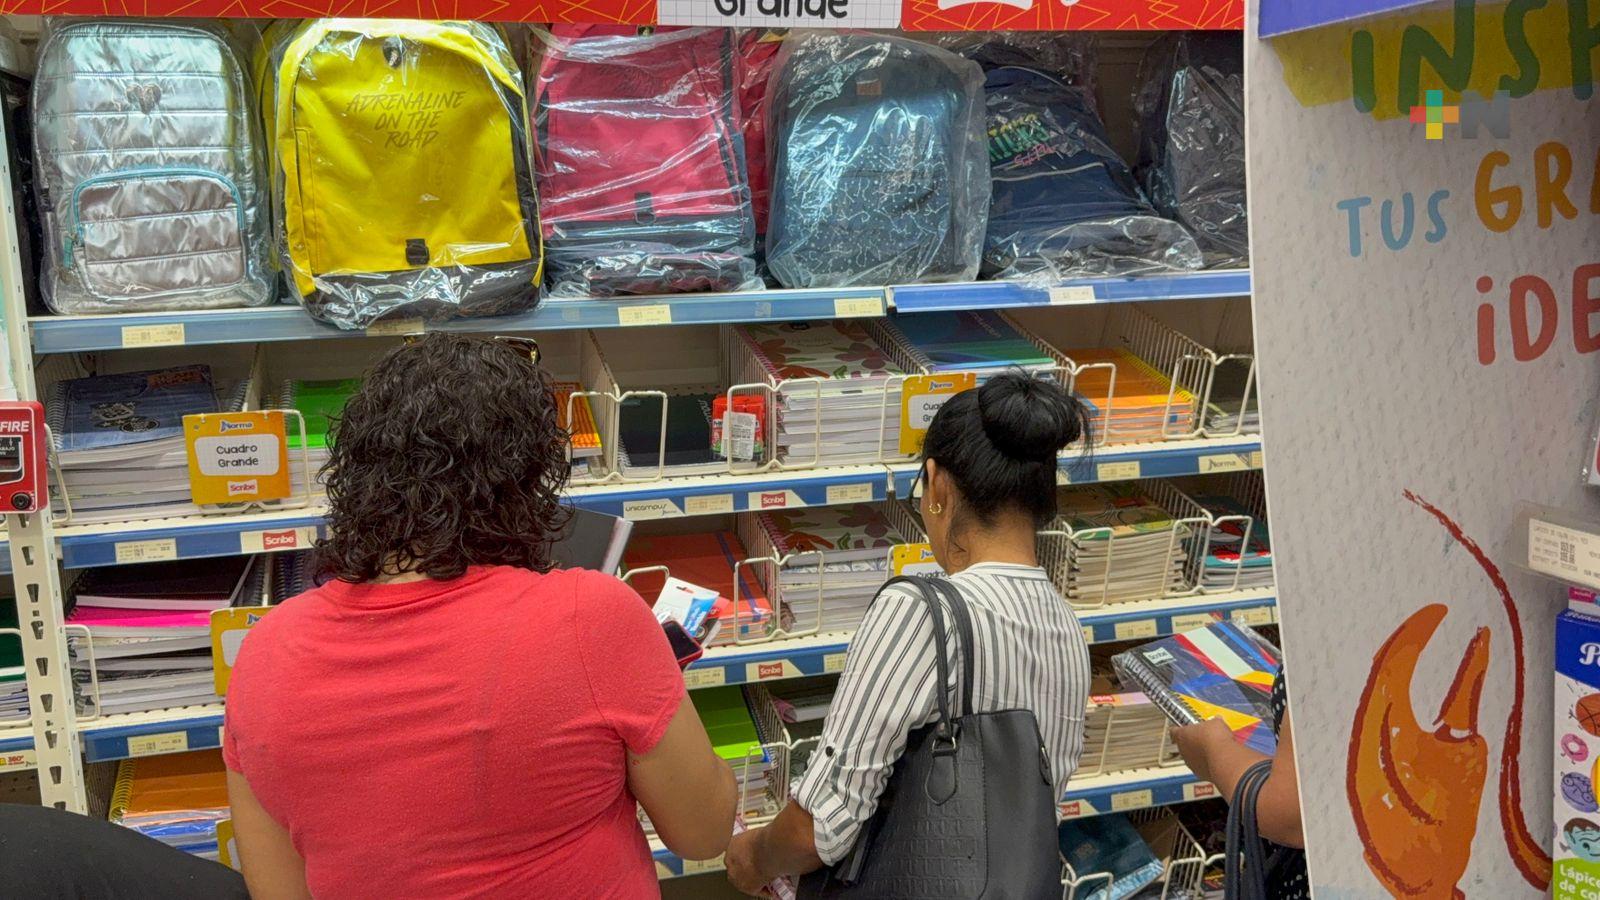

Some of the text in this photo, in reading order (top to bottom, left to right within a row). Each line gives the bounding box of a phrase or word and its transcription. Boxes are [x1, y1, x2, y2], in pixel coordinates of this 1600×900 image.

[346, 91, 466, 112] ADRENALINE
[374, 110, 443, 130] ON THE
[384, 130, 438, 148] ROAD
[1336, 141, 1600, 258] TUS GR
[220, 420, 253, 433] Norma
[216, 444, 258, 455] Cuadro
[218, 457, 259, 468] Grande
[1208, 458, 1236, 471] Norma
[229, 483, 257, 493] Scribe
[762, 496, 784, 506] Scribe
[264, 535, 295, 545] Scribe
[760, 666, 782, 676] Scribe
